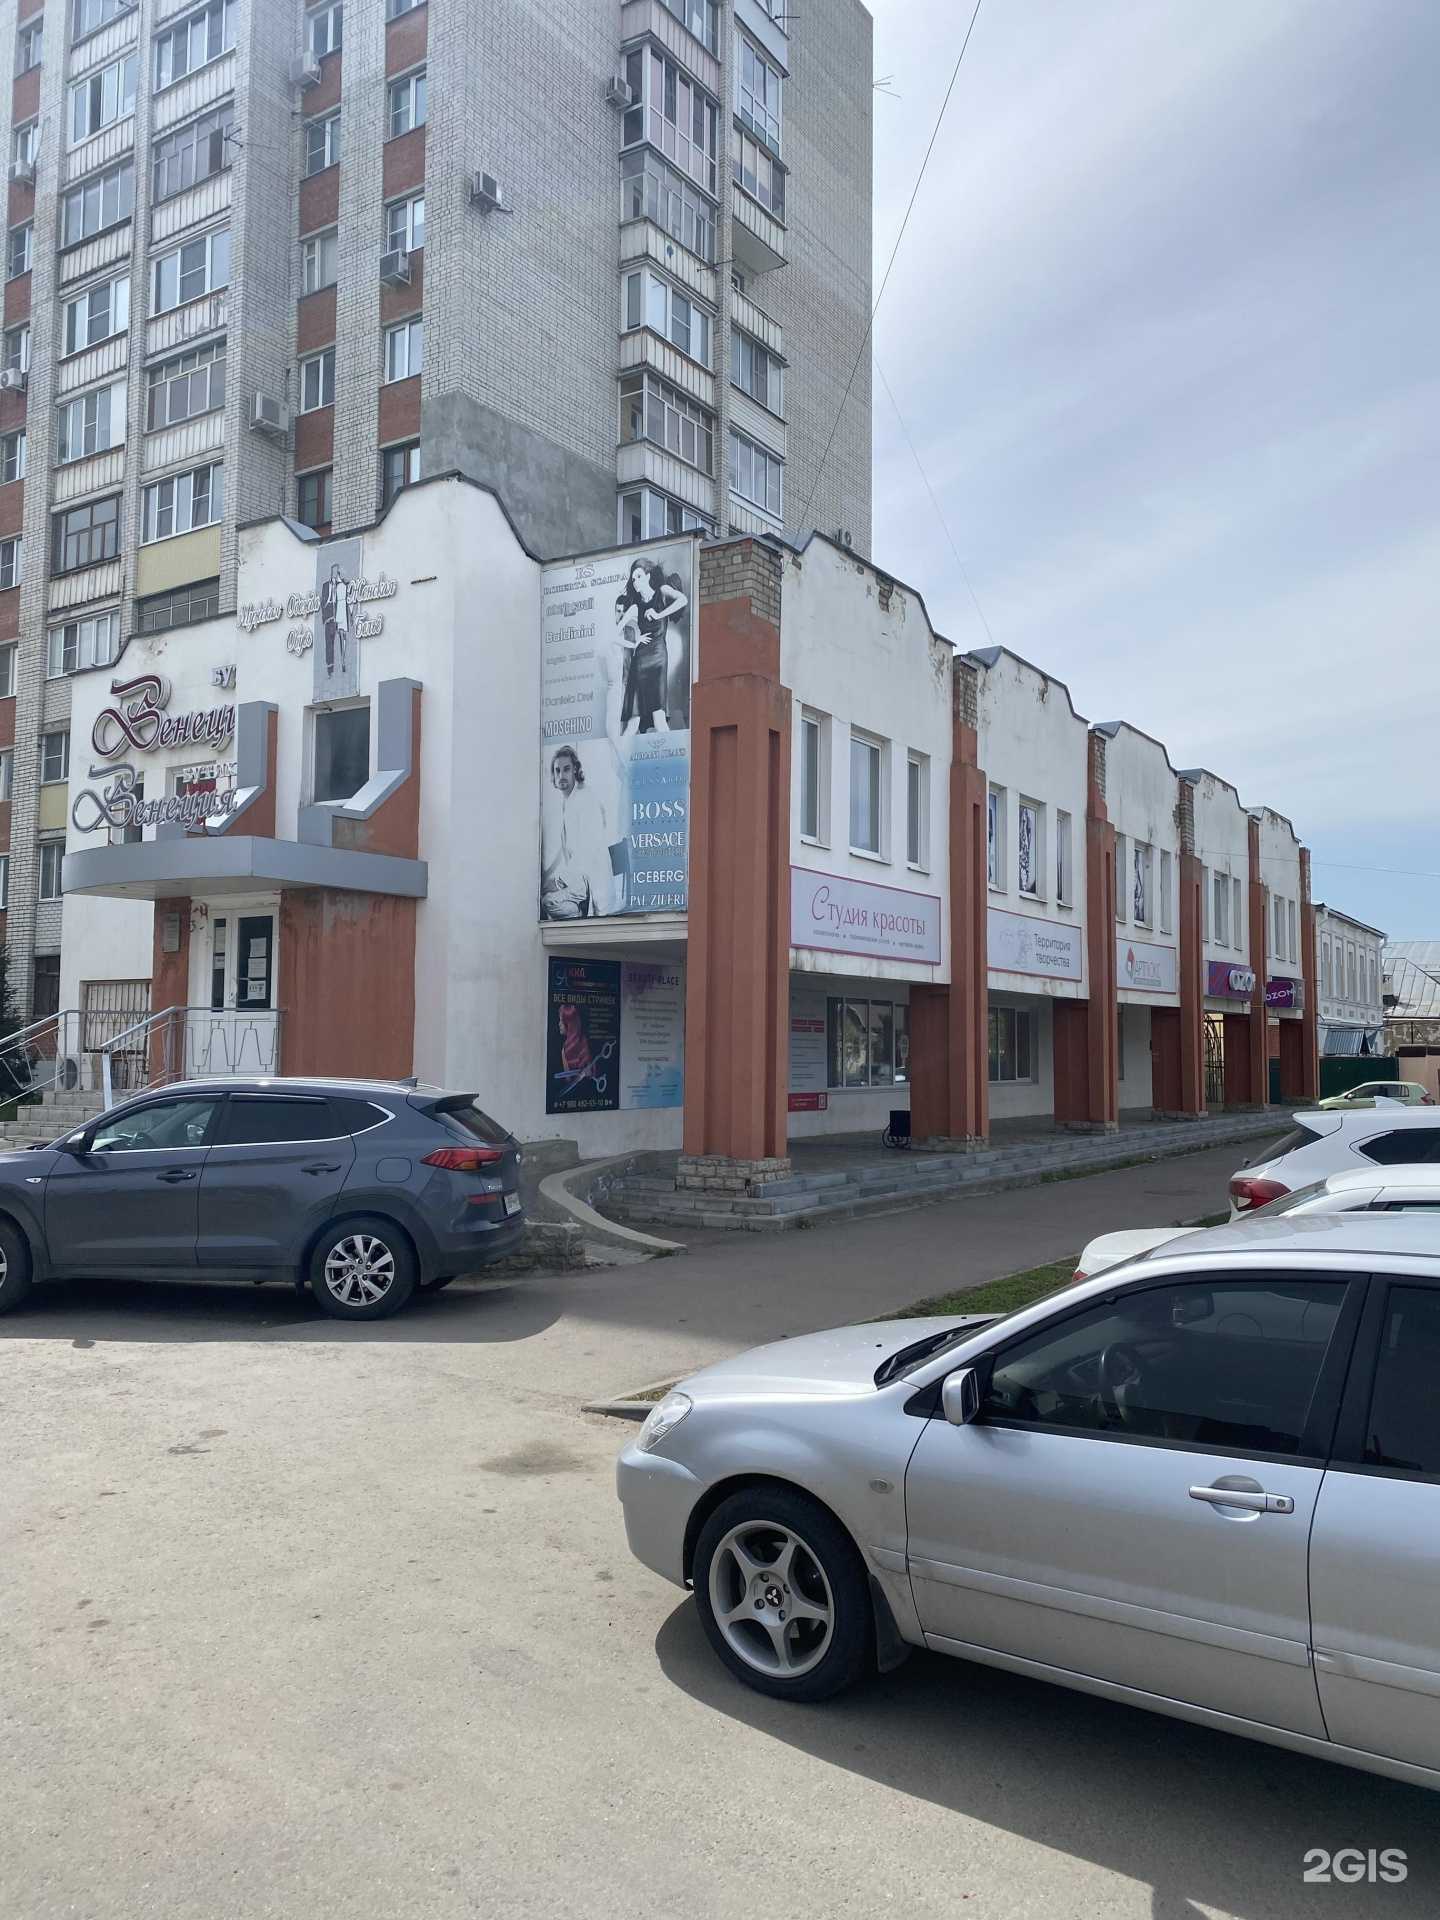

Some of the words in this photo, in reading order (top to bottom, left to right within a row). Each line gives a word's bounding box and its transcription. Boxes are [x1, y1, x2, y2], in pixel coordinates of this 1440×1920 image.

[347, 577, 397, 604] Женская
[544, 623, 595, 643] Baldinini
[543, 715, 593, 738] MOSCHINO
[72, 762, 238, 834] Венеция
[633, 800, 685, 820] BOSS
[631, 832, 685, 849] VERSACE
[633, 870, 685, 884] ICEBERG
[811, 886, 868, 929] Студия
[873, 912, 926, 936] красоты
[1033, 933, 1072, 952] Территория
